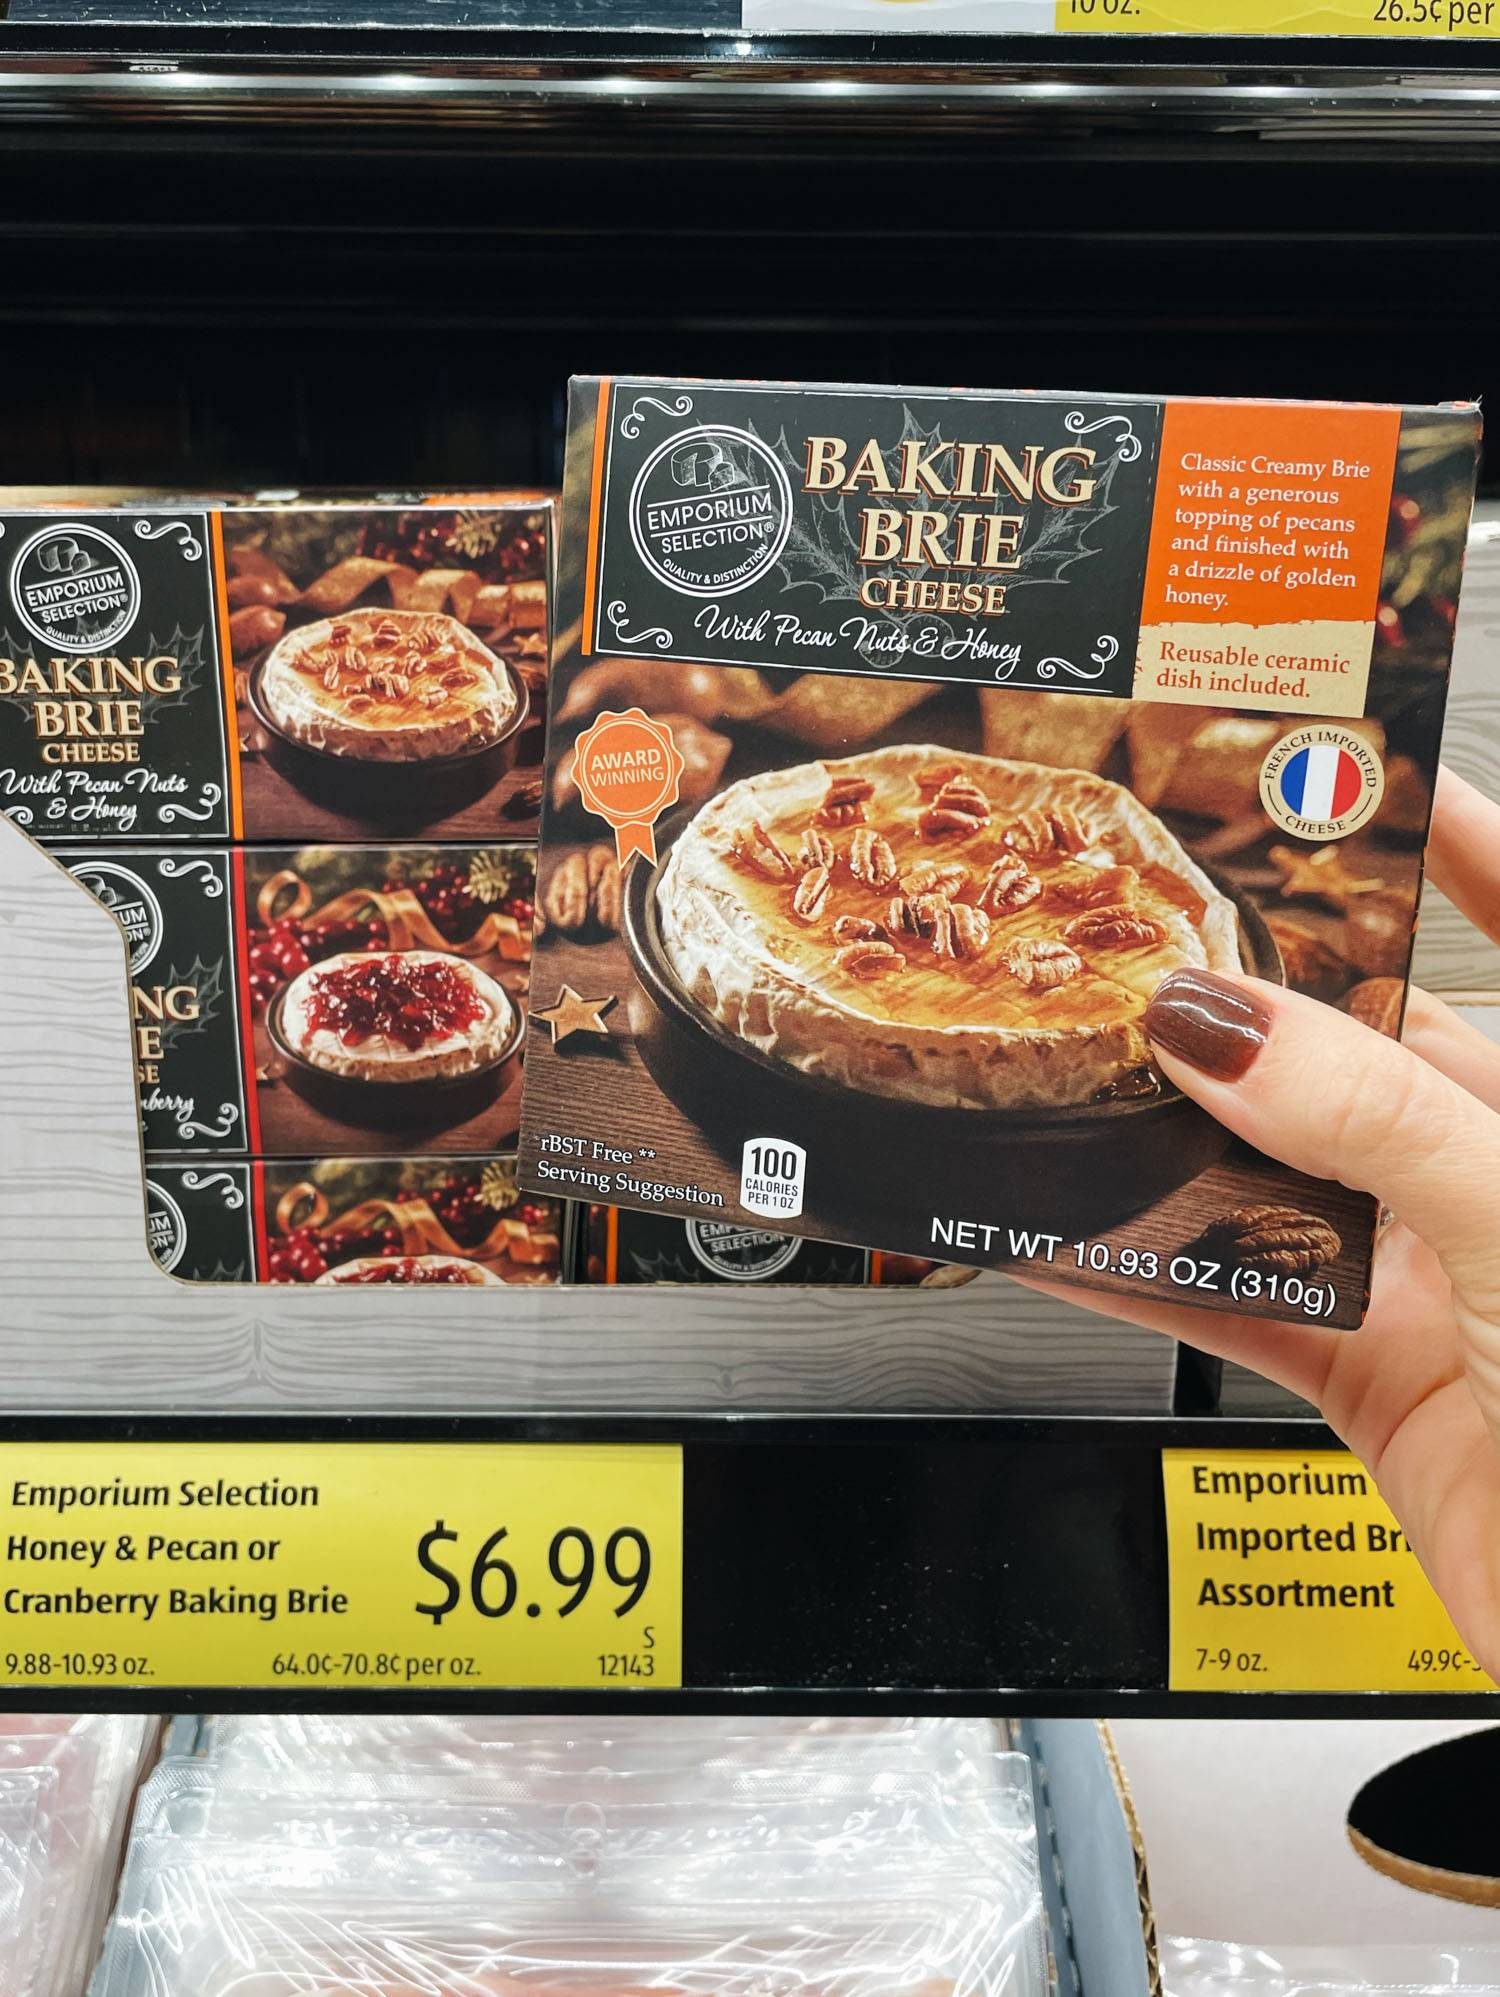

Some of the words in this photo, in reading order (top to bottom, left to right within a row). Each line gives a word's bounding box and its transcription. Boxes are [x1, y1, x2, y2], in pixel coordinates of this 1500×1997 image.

[1448, 0, 1495, 32] per
[801, 435, 1099, 507] BAKING
[1180, 453, 1247, 473] Classic
[1251, 456, 1327, 481] Creamy
[1332, 459, 1371, 479] Brie
[1178, 480, 1223, 499] with
[1228, 487, 1240, 500] a
[1245, 487, 1340, 506] generous
[647, 492, 773, 531] EMPORIUM
[1175, 507, 1254, 532] topping
[1259, 510, 1282, 529] of
[1285, 517, 1356, 535] pecans
[857, 507, 1024, 572] BRIE
[1171, 534, 1209, 552] and
[1215, 535, 1297, 557] finished
[1303, 540, 1350, 560] with
[663, 558, 703, 584] QUALITY
[704, 574, 711, 585] &
[713, 543, 769, 584] DISTINCTION
[1168, 564, 1179, 577] a
[1185, 560, 1255, 581] drizzle
[1260, 565, 1282, 583] of
[1285, 567, 1357, 589] golden
[26, 571, 124, 607] EMPORIUM
[857, 577, 1008, 616] CHEESE
[1165, 584, 1229, 611] honey.
[694, 604, 772, 642] With
[773, 614, 837, 647] Pecan
[840, 617, 912, 652] Nuts
[912, 626, 939, 655] &
[941, 627, 1022, 681] Honey
[1159, 640, 1259, 668] Reusable
[1265, 652, 1351, 674] ceramic
[1156, 667, 1202, 690] dish
[1208, 670, 1311, 698] included.
[33, 700, 145, 739] BRIE
[42, 742, 141, 764] CHEESE
[591, 748, 661, 771] AWARD
[1264, 732, 1313, 780] FRENCH
[1318, 731, 1377, 788] IMPORTED
[0, 768, 63, 795] With
[65, 770, 124, 795] Pecan
[124, 768, 188, 794] Nuts
[590, 766, 665, 788] WINNING
[46, 797, 68, 819] &
[70, 794, 138, 832] Honey
[1285, 815, 1347, 834] CHEESE
[540, 1134, 588, 1157] rBST
[592, 1141, 633, 1165] Free
[751, 1145, 798, 1181] 100
[537, 1160, 611, 1193] Serving
[615, 1172, 724, 1207] Suggestion
[745, 1178, 799, 1198] CALORIES
[748, 1191, 769, 1206] PER
[780, 1194, 795, 1209] OZ
[930, 1217, 1000, 1252] NET
[1008, 1229, 1063, 1263] WT
[1073, 1242, 1159, 1280] 10.93
[1169, 1256, 1222, 1291] OZ
[1230, 1267, 1337, 1317] (310g)
[12, 1478, 171, 1514] Emporium
[178, 1478, 320, 1507] Selection
[1193, 1463, 1368, 1503] Emporium
[7, 1535, 107, 1568] Honey
[115, 1535, 137, 1561] &
[147, 1535, 239, 1561] Pecan
[248, 1539, 281, 1561] or
[1197, 1521, 1356, 1559] Imported
[1367, 1524, 1412, 1552] Br
[415, 1519, 652, 1625] $6.99
[4, 1587, 160, 1621] Cranberry
[169, 1586, 278, 1621] Baking
[288, 1585, 350, 1614] Brie
[1198, 1577, 1395, 1608] Assortment
[643, 1626, 655, 1649] S
[5, 1653, 117, 1676] 9.88-10.93
[123, 1657, 156, 1676] oz.
[272, 1653, 401, 1676] 64.0¢-70.8¢
[406, 1655, 446, 1681] per
[450, 1655, 482, 1677] oz.
[597, 1654, 655, 1677] 12143
[1196, 1648, 1231, 1672] 7-9
[1237, 1653, 1269, 1672] oz.
[1408, 1649, 1482, 1672] 49.9¢-
